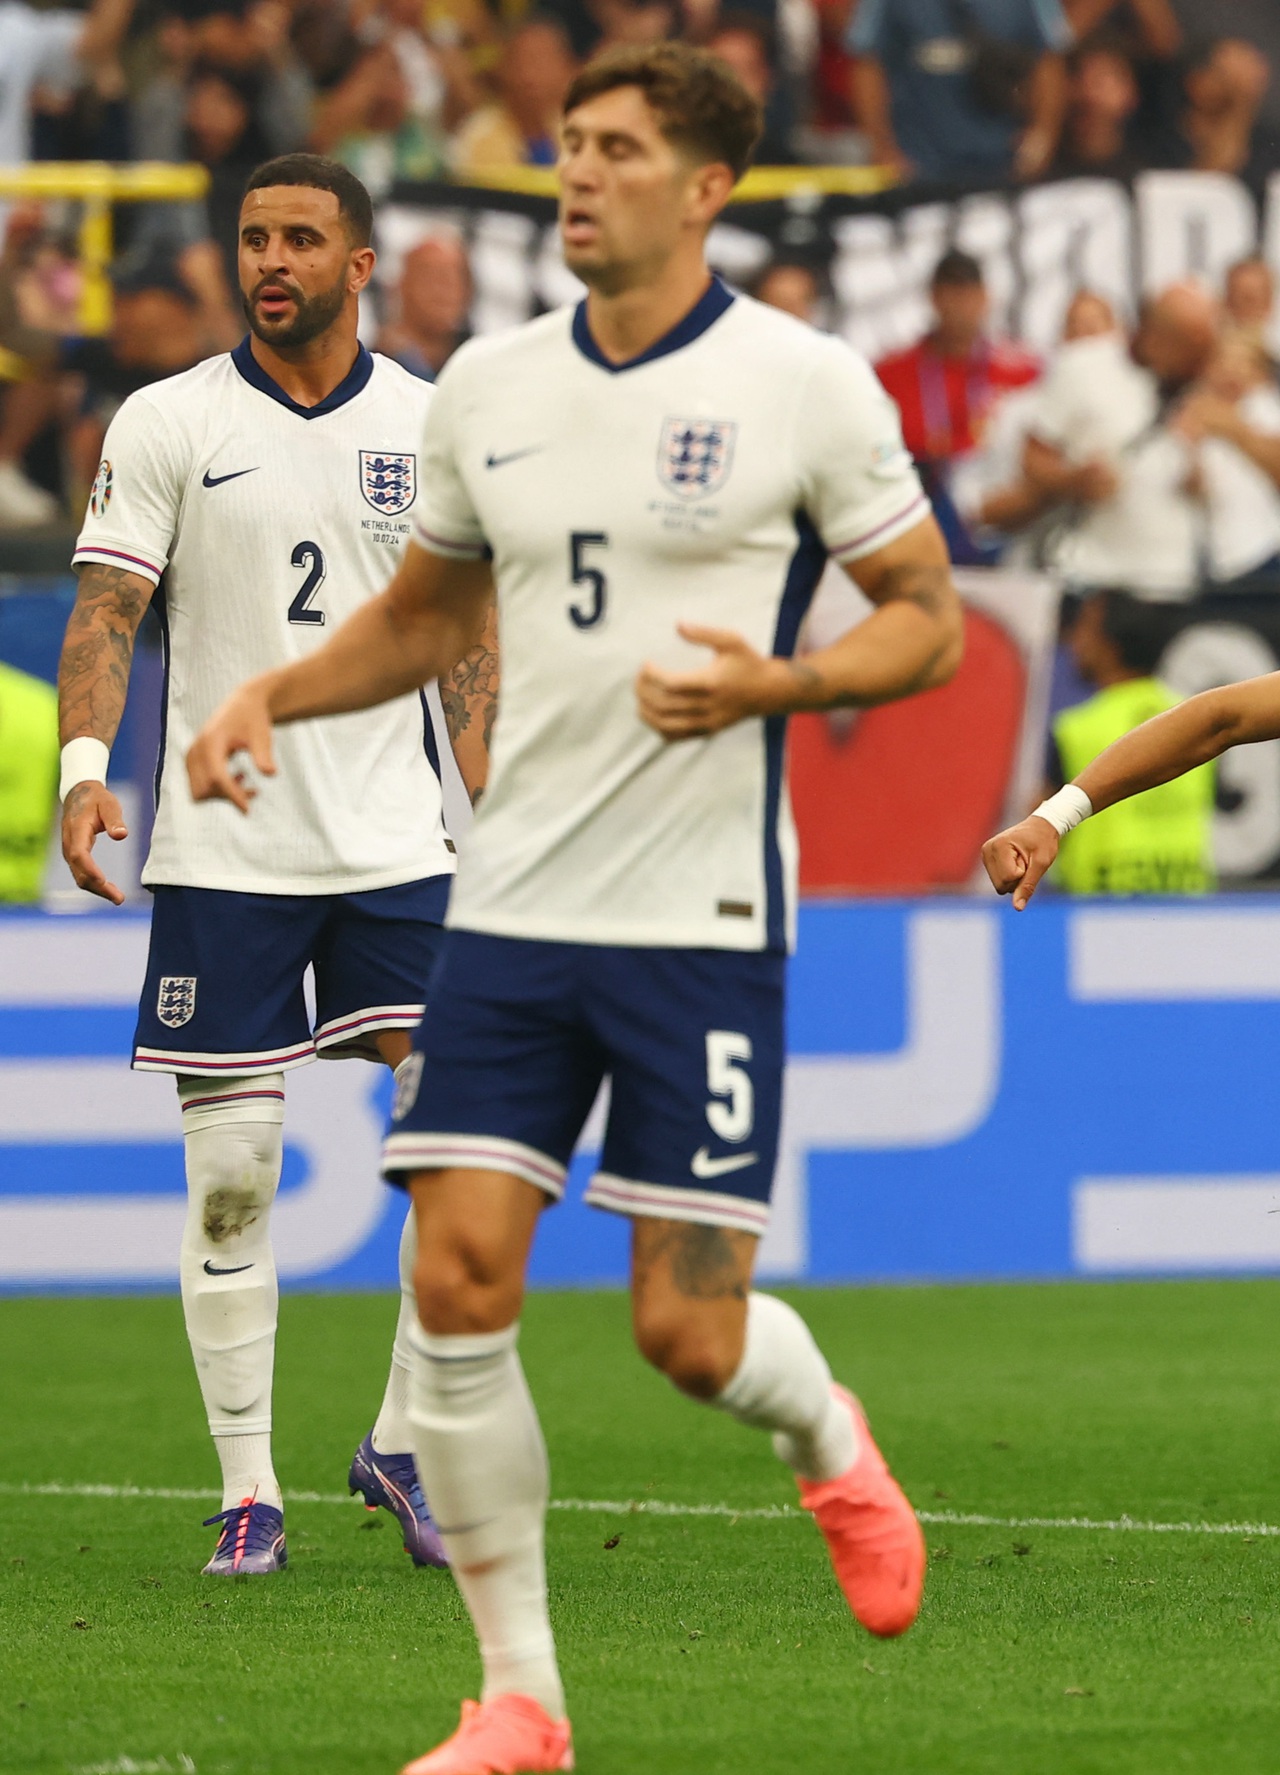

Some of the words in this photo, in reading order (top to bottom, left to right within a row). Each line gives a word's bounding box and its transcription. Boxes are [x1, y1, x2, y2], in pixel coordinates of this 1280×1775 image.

[361, 520, 411, 534] NETHERLANDS
[372, 533, 400, 545] 10.07.24
[288, 541, 327, 625] 2
[567, 531, 608, 630] 5
[705, 1029, 754, 1143] 5
